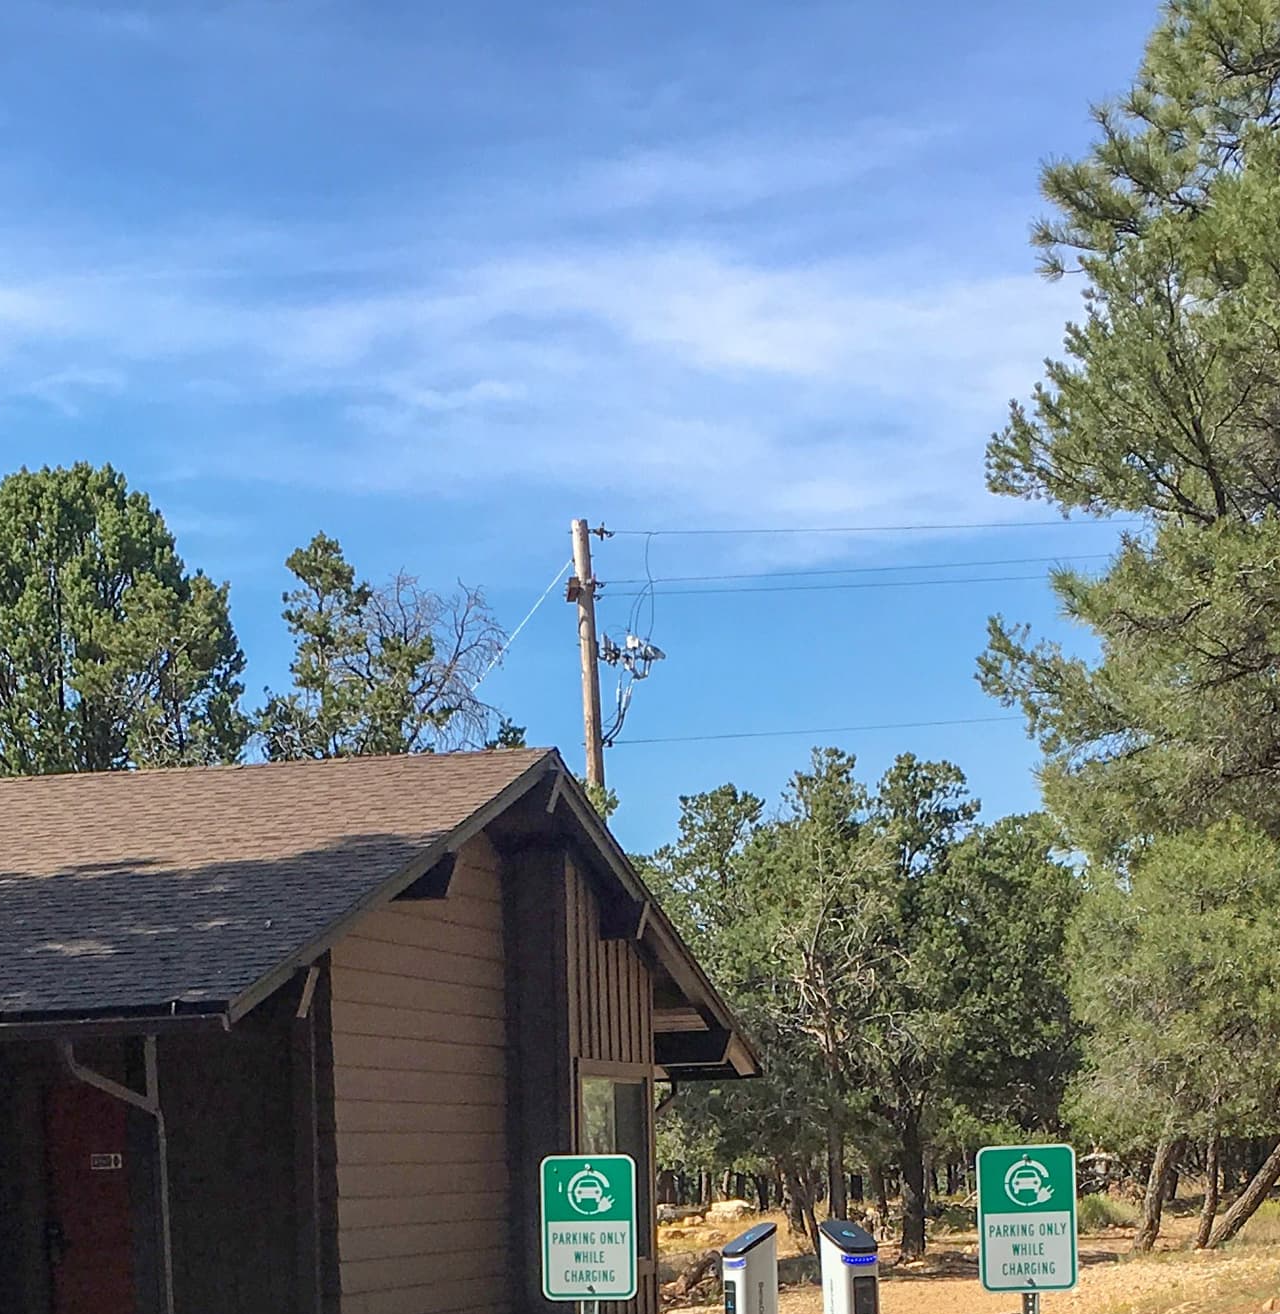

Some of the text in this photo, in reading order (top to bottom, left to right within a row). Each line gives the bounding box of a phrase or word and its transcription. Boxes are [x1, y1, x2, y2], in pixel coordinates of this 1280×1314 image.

[989, 1223, 1066, 1237] PARKING ONLY
[552, 1232, 627, 1245] PARKING ONLY
[1012, 1243, 1044, 1255] WHILE
[574, 1251, 605, 1264] WHILE
[1002, 1262, 1055, 1275] CHARGING
[564, 1270, 615, 1282] CHARGING
